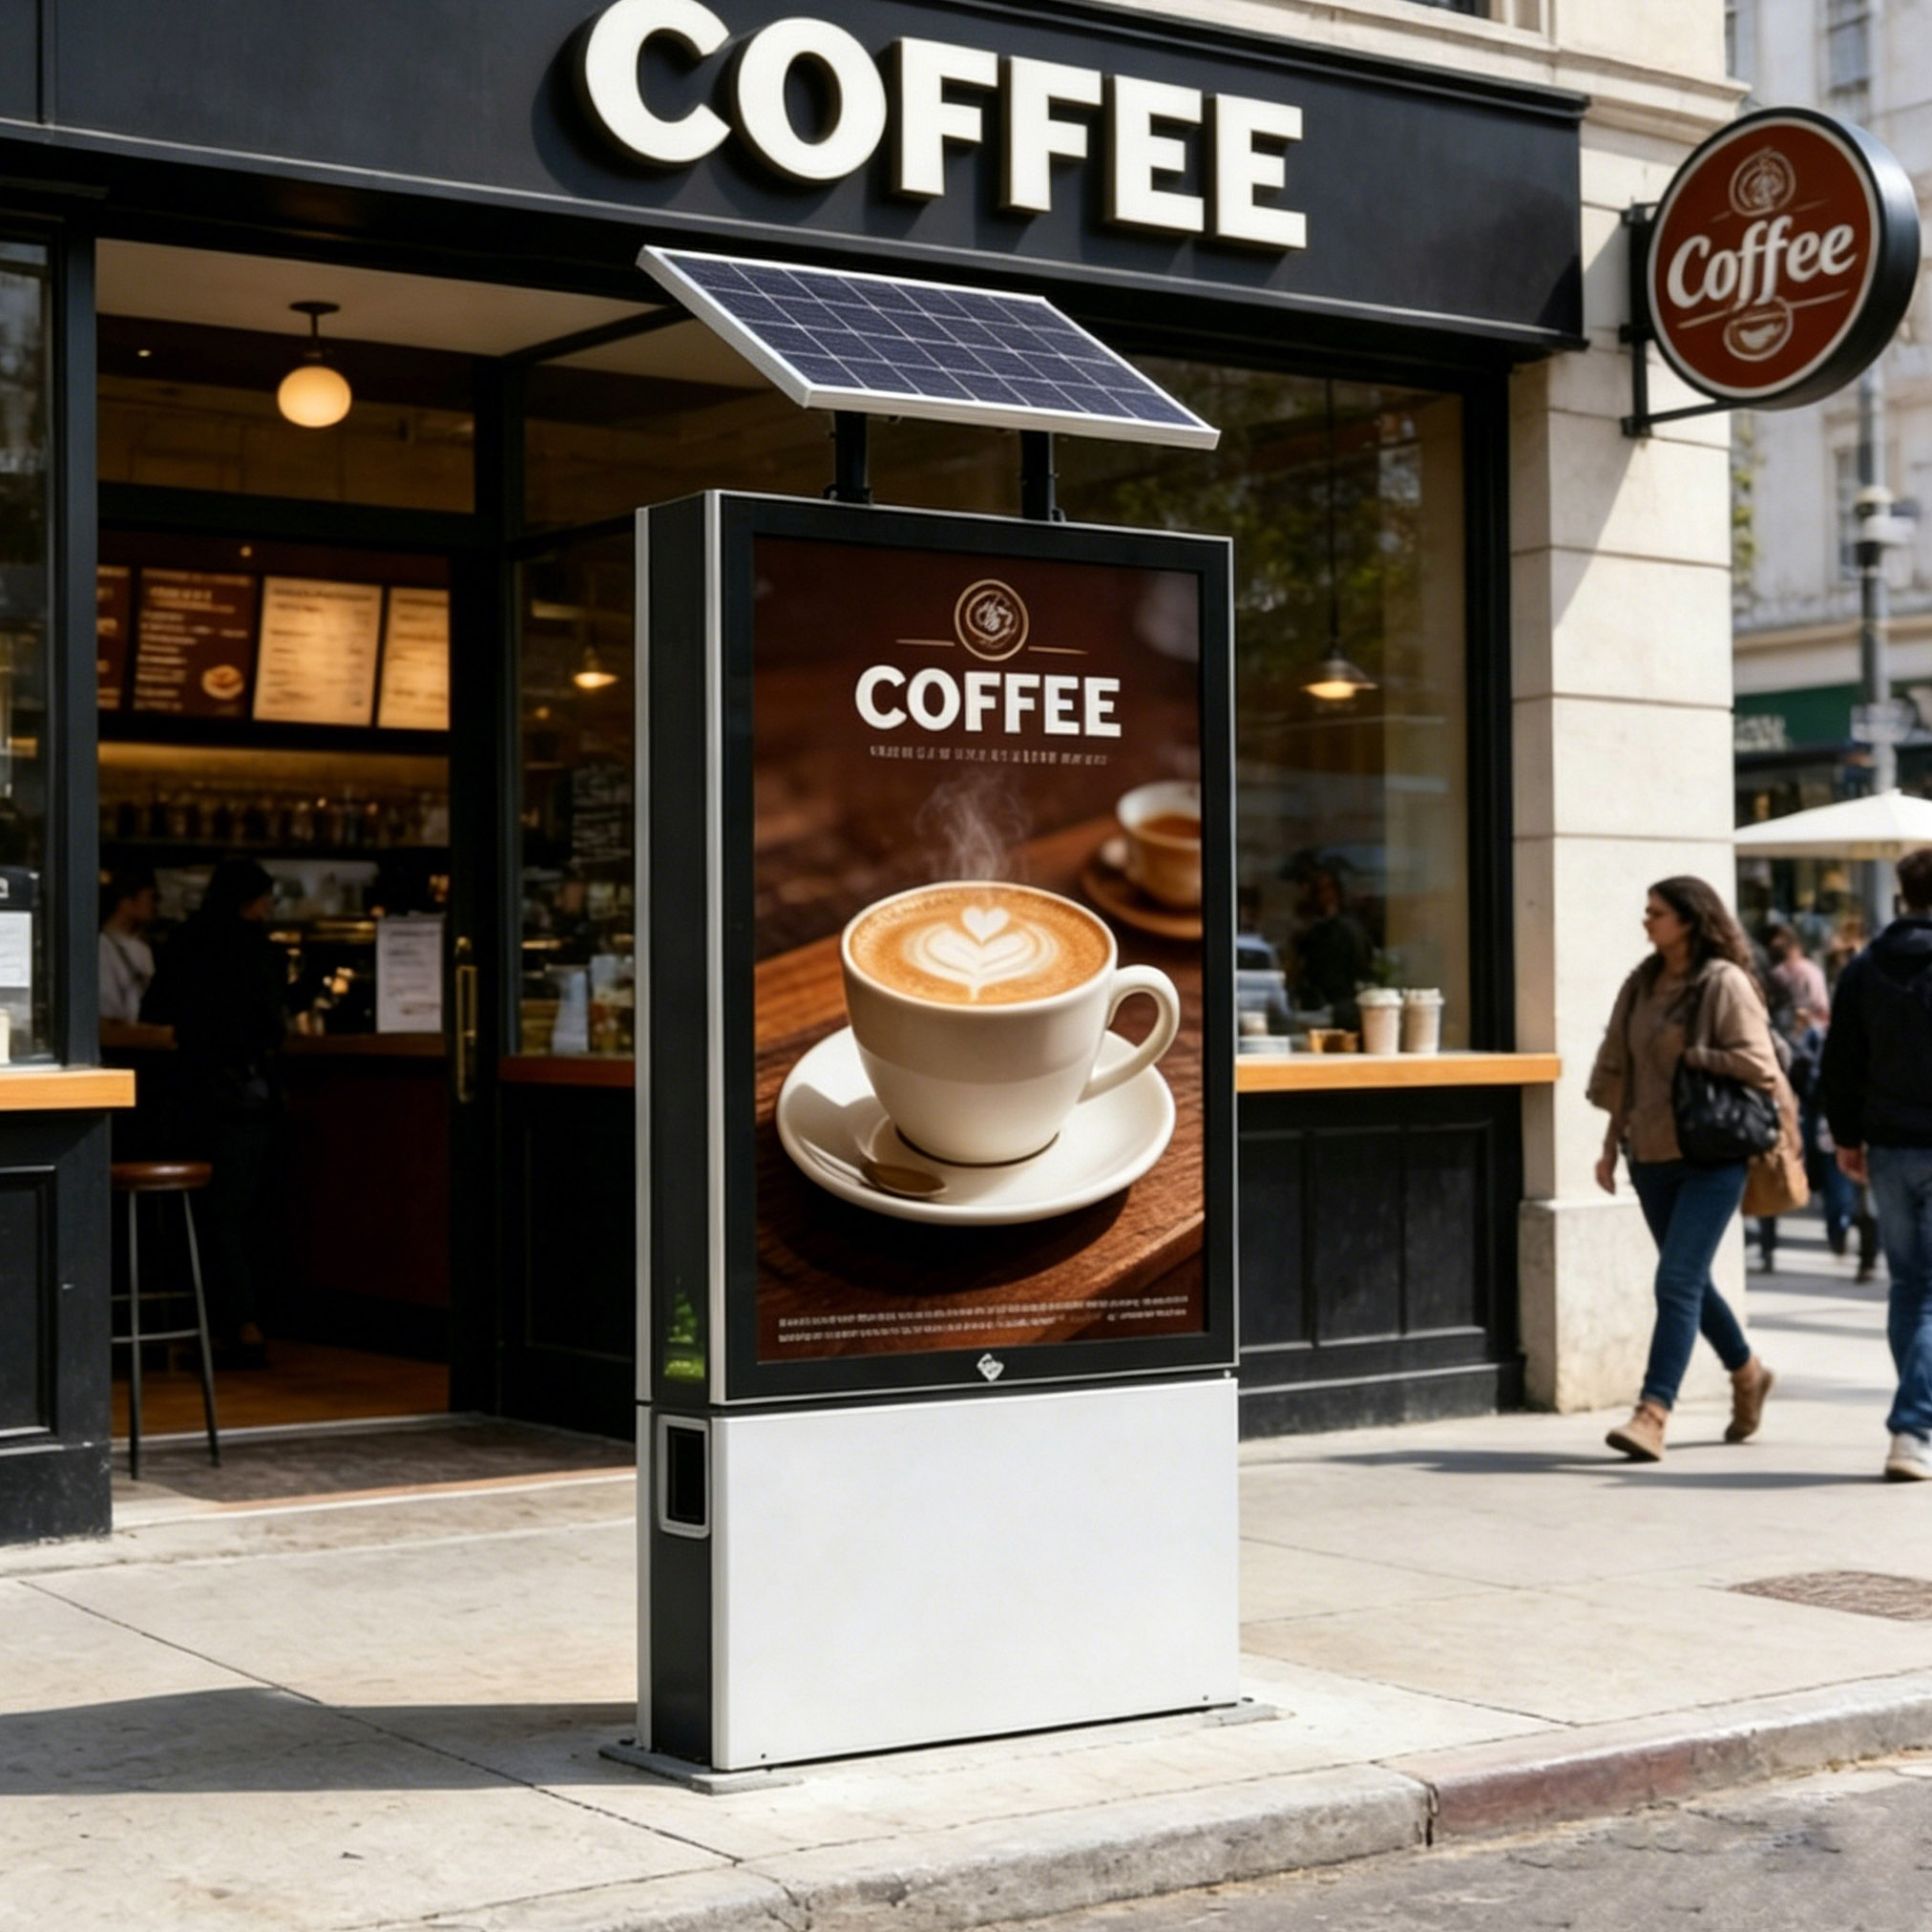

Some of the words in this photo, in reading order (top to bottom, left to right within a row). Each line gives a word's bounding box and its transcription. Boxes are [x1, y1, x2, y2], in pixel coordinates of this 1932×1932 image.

[584, 0, 1307, 250] COFFEE
[1667, 215, 1858, 312] Coffee
[855, 665, 1122, 737] COFFEE
